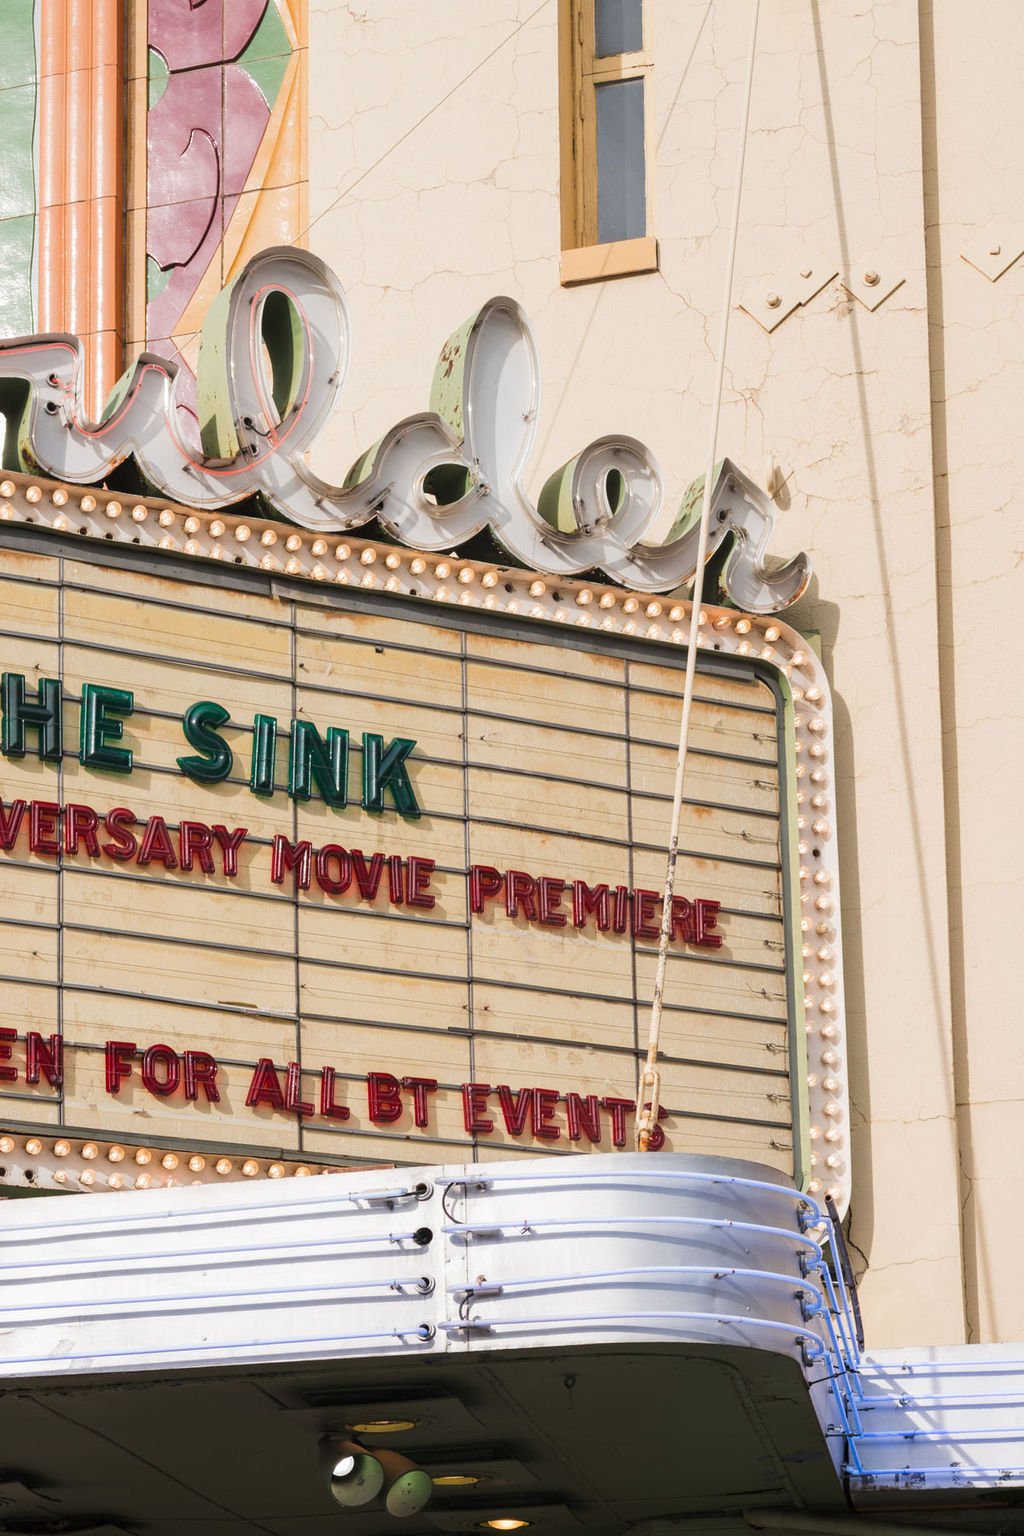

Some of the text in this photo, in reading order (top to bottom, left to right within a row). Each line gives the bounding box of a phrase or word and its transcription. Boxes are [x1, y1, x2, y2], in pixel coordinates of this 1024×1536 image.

[176, 700, 422, 820] SINK
[270, 833, 436, 909] MOVIE
[469, 863, 724, 949] PREMIERE
[105, 1040, 219, 1102] FOR
[245, 1057, 351, 1121] ALL
[367, 1071, 438, 1129] BT
